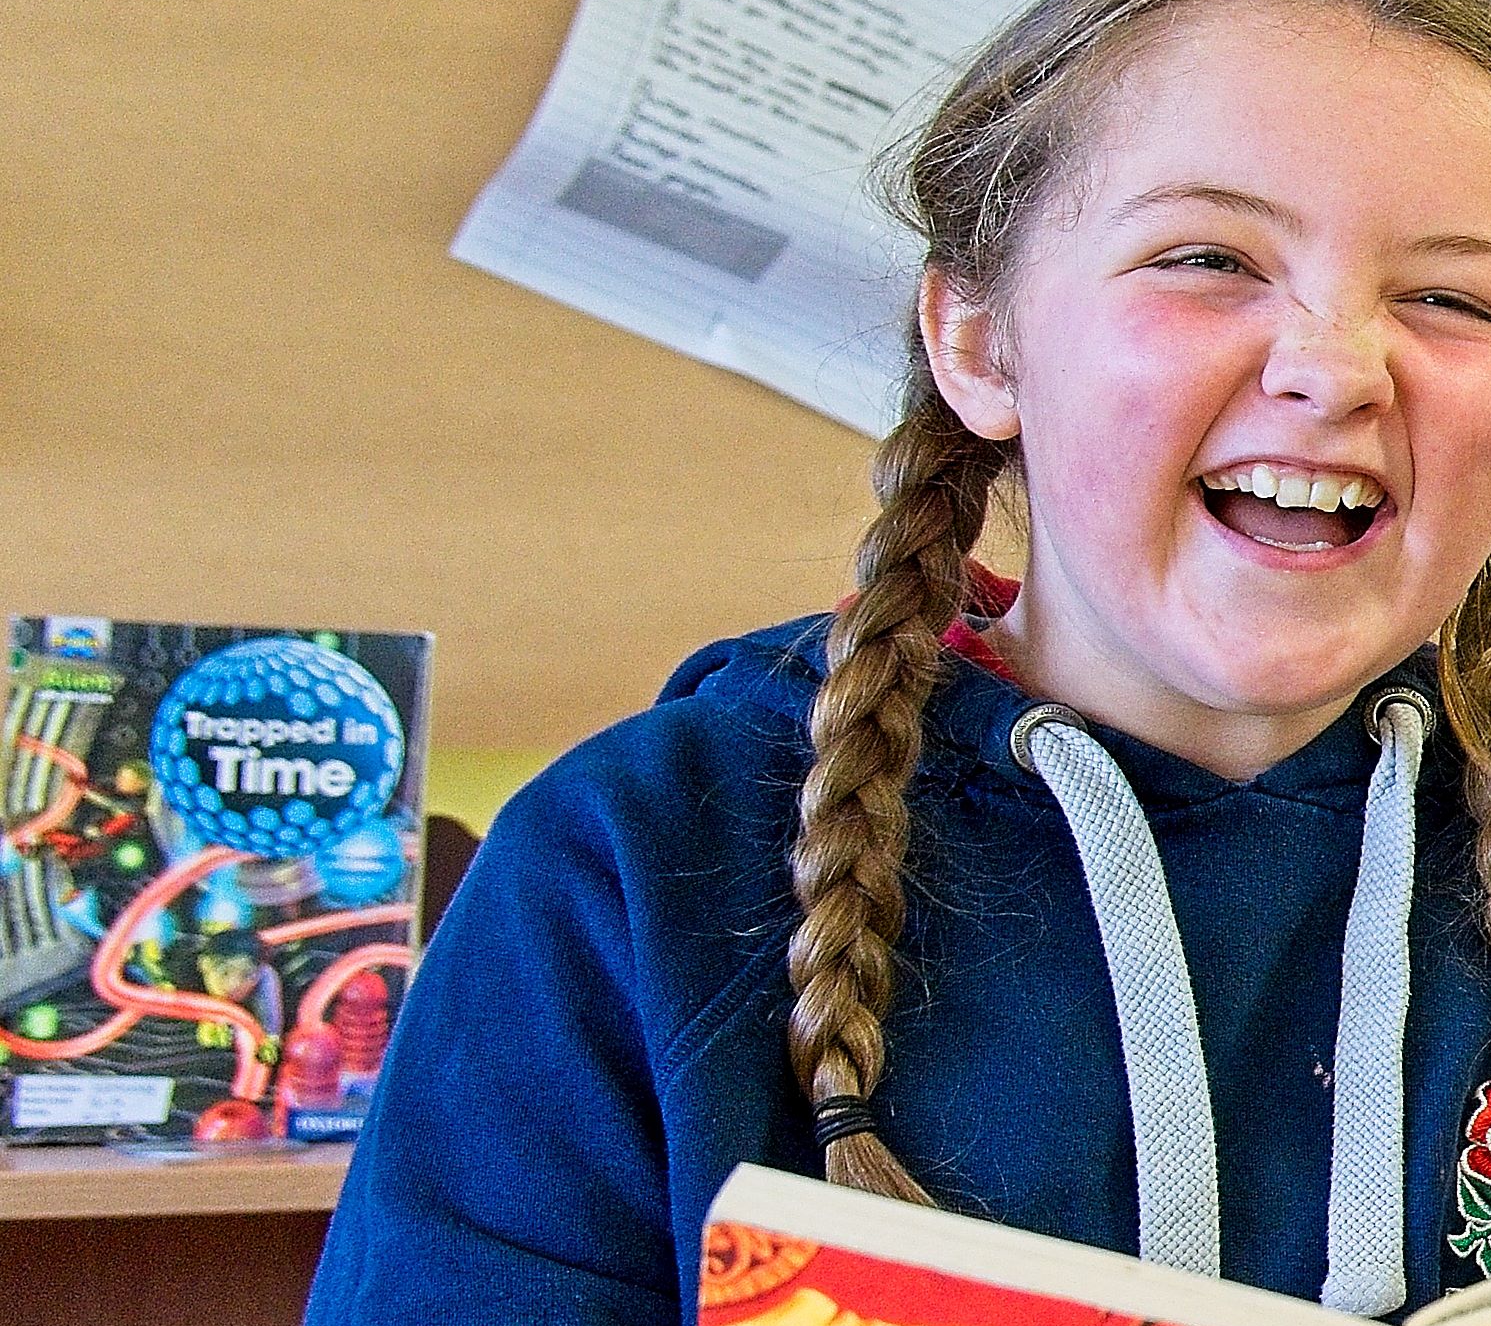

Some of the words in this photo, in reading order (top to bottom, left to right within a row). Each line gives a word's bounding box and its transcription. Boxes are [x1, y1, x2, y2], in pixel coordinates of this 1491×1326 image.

[182, 710, 337, 750] Trapped
[341, 717, 379, 745] in
[205, 743, 358, 799] Time
